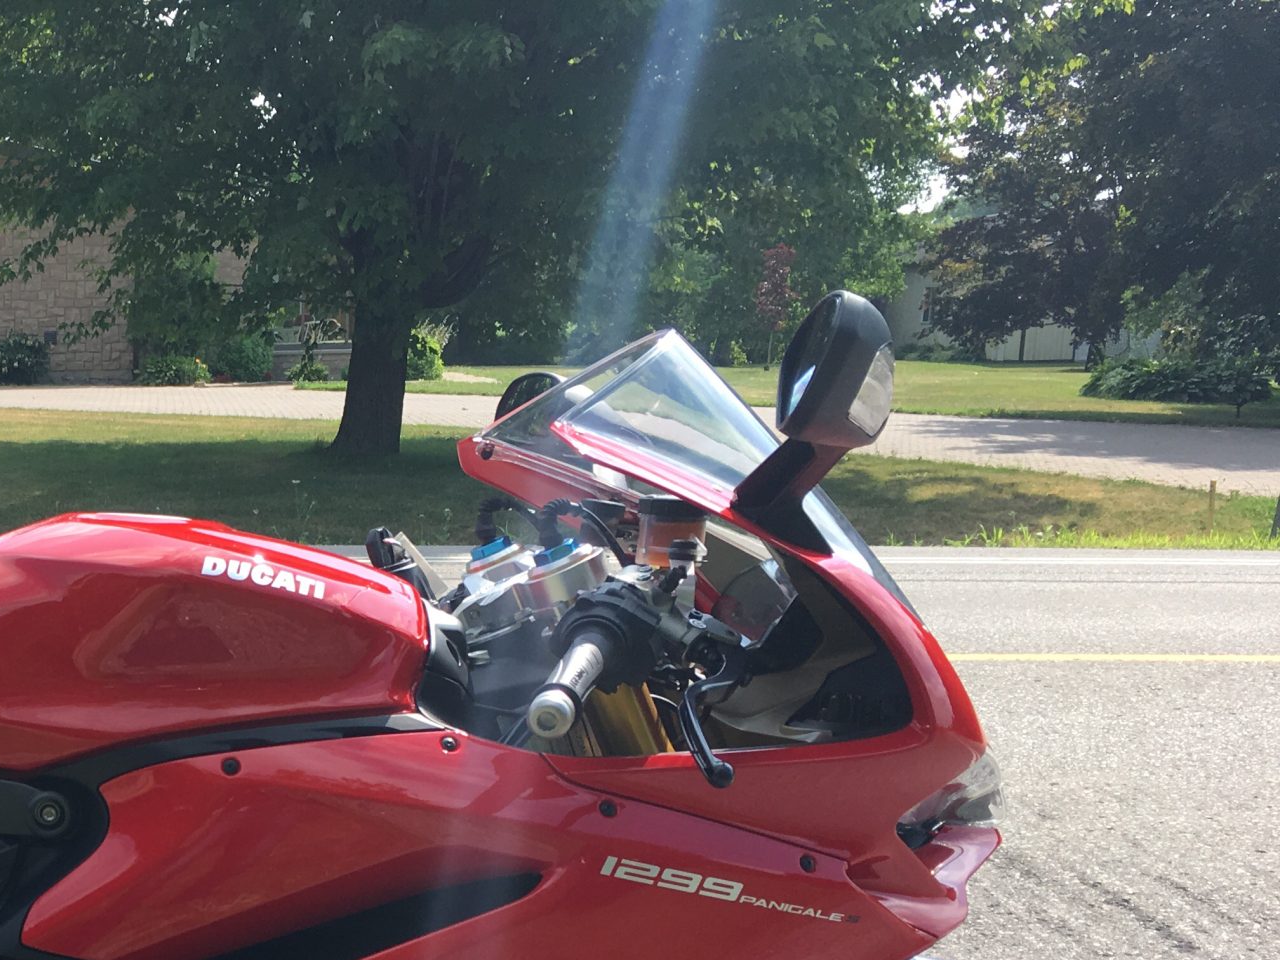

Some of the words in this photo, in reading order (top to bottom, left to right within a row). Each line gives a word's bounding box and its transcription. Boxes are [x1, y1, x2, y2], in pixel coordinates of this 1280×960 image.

[201, 555, 326, 600] DUCATI
[600, 855, 744, 902] 1299
[739, 895, 845, 923] PANIGALE
